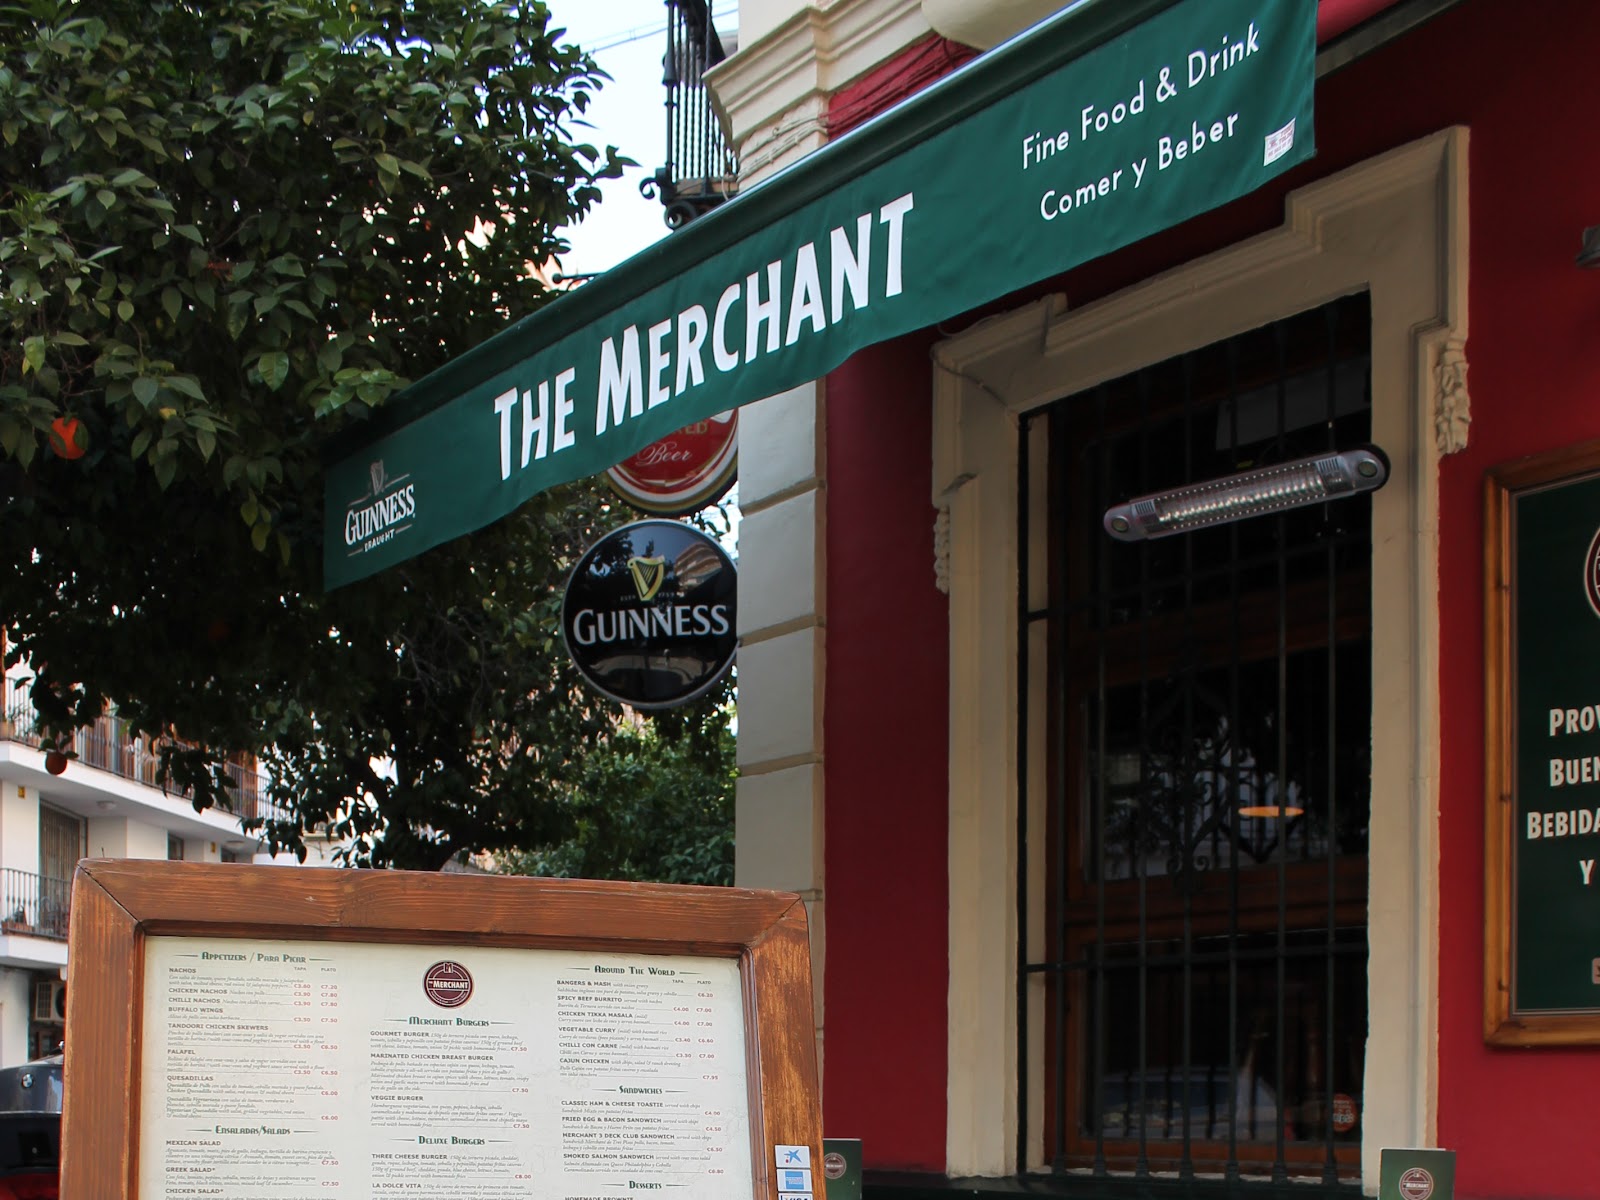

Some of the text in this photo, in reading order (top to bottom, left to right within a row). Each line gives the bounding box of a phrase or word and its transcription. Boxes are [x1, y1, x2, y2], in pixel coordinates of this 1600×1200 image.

[1022, 21, 1260, 170] Fine Food & Drink
[1039, 169, 1123, 221] Comer
[1131, 157, 1148, 188] y
[1158, 113, 1239, 171] Beber
[493, 191, 915, 481] THE MERCHANT
[638, 440, 693, 466] Beer
[344, 483, 416, 546] GUINNESS
[364, 528, 395, 553] DRAUGHT
[572, 604, 730, 646] GUINNESS
[1579, 859, 1595, 885] Y
[201, 951, 307, 964] APPETIZERS PARA PICAR
[594, 964, 676, 976] AROUND THE WORLD
[432, 979, 469, 990] MERCHANT
[408, 1016, 490, 1027] MERCHANT BURGERS
[559, 1057, 580, 1065] CAJUN
[618, 1084, 663, 1095] SANDWICHES
[418, 1135, 486, 1146] DELUXE BURGERS
[628, 1180, 662, 1190] DESSERTS
